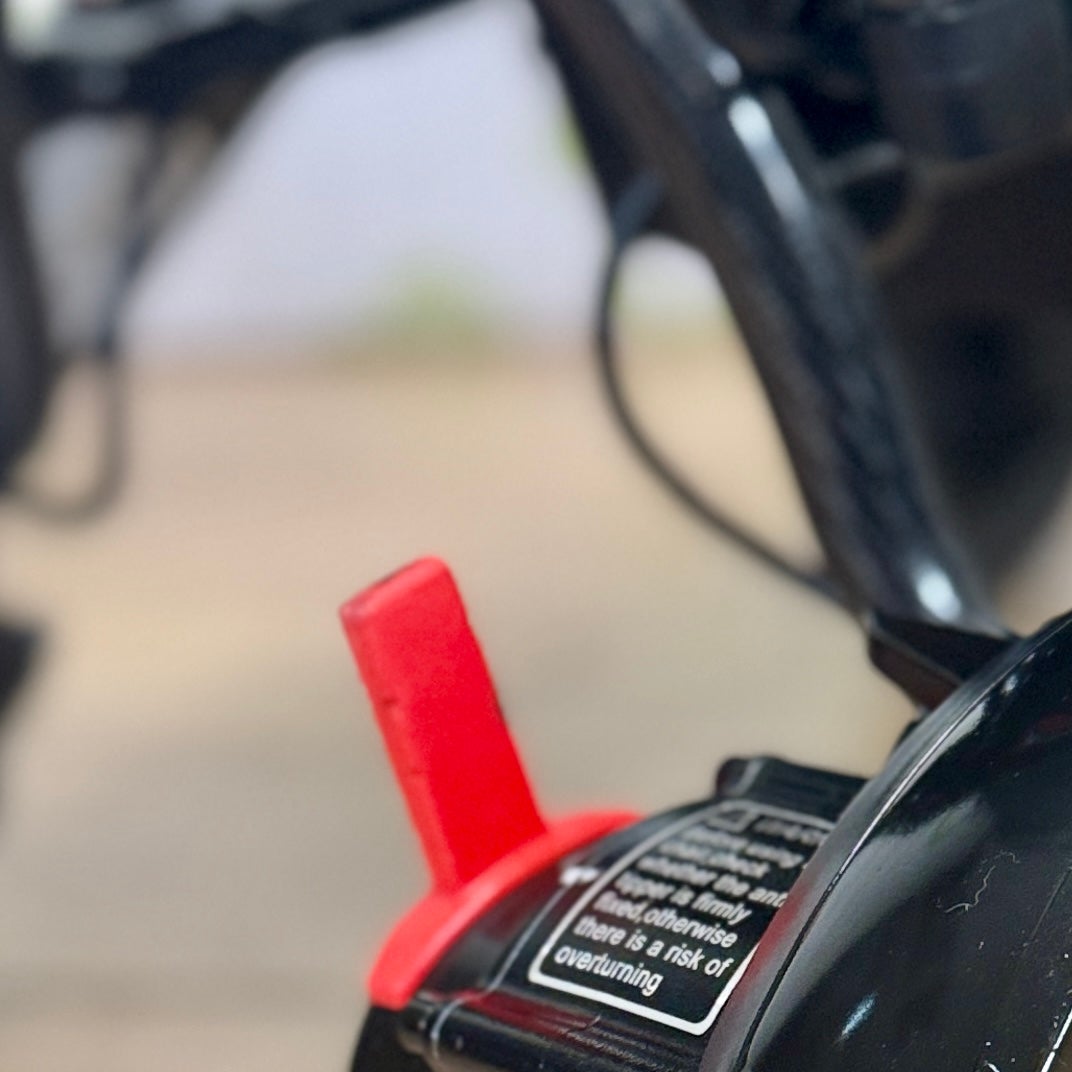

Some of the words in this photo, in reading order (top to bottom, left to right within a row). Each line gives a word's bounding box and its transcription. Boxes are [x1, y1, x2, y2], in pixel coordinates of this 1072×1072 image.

[671, 887, 695, 905] is
[693, 892, 753, 925] firmly
[713, 874, 750, 896] the
[573, 914, 627, 945] there
[625, 928, 648, 951] is
[646, 941, 664, 958] a
[663, 942, 706, 971] risk
[704, 957, 736, 978] of
[554, 945, 664, 997] overturning
